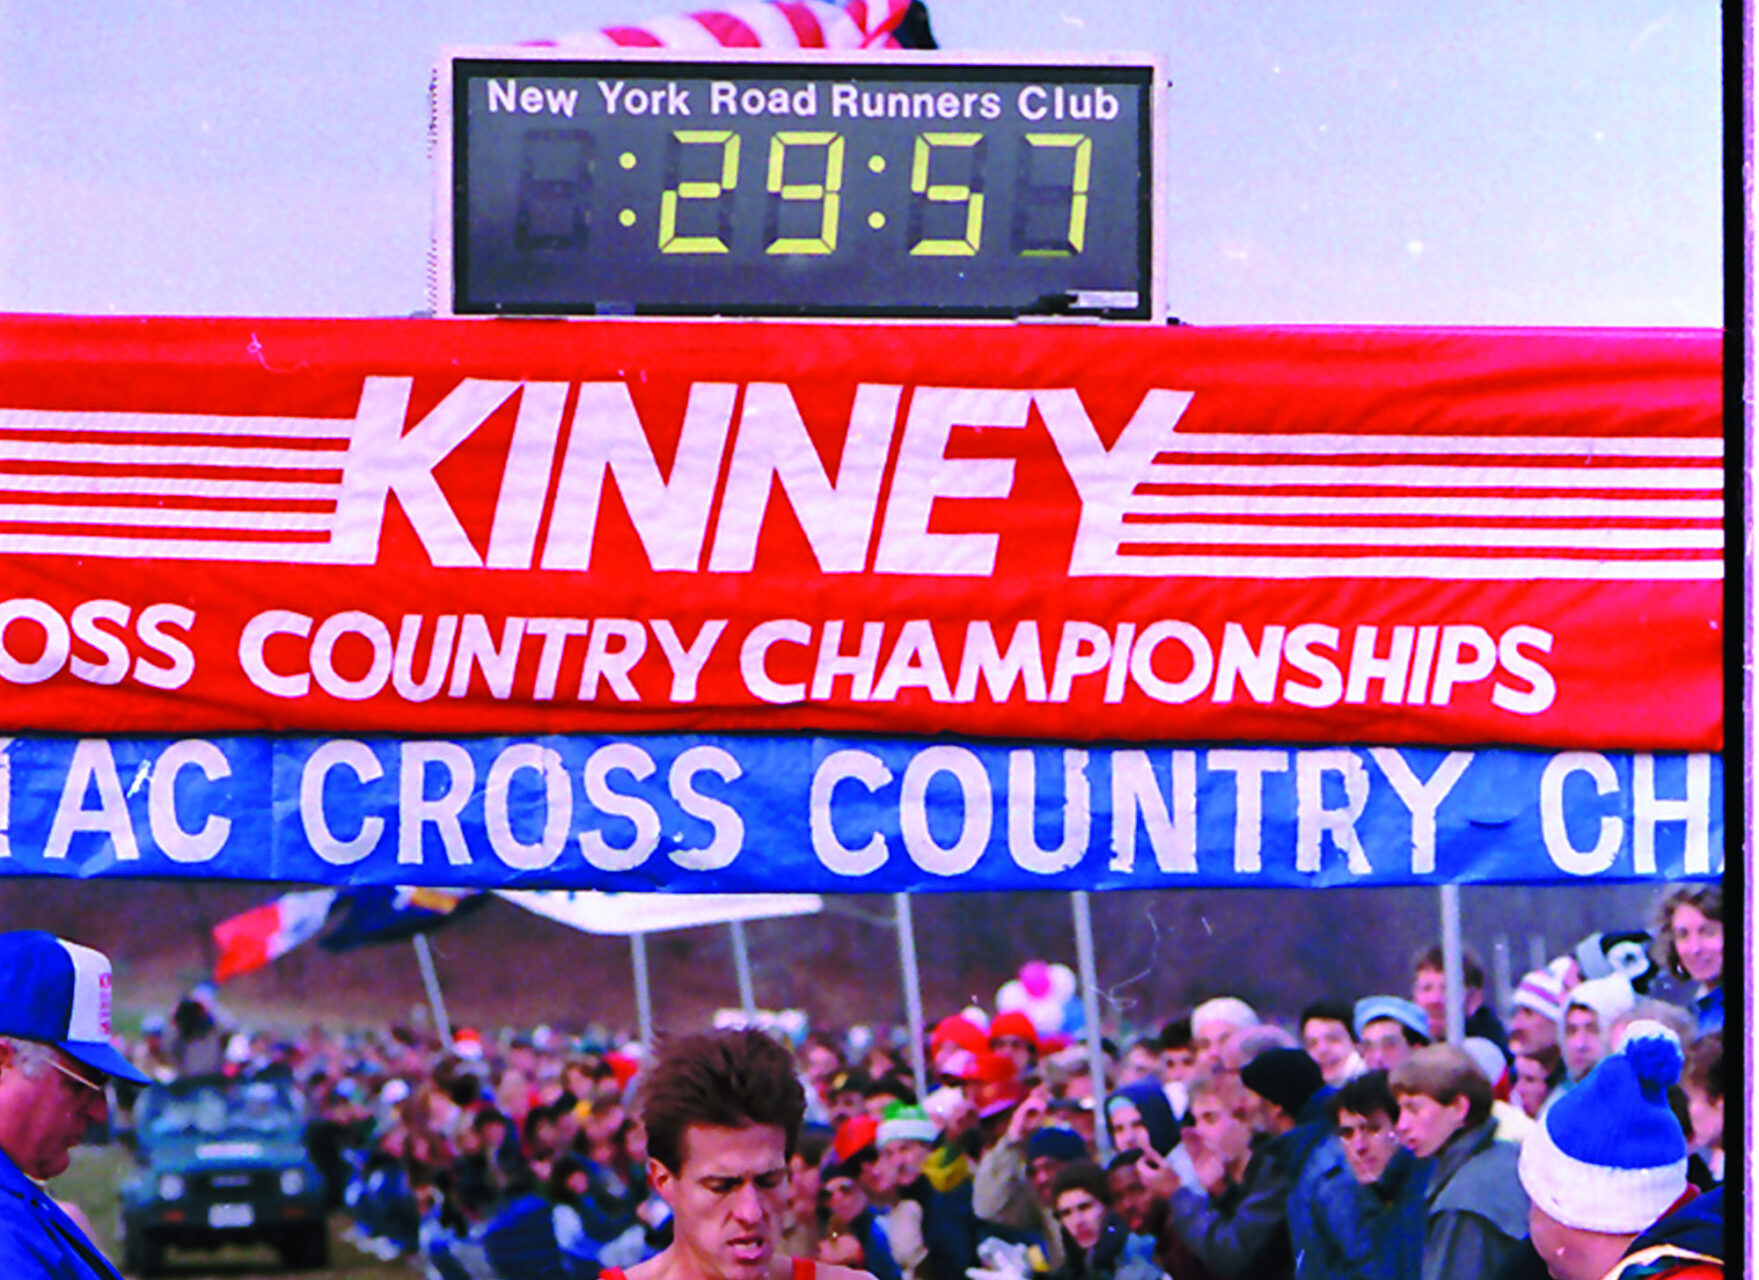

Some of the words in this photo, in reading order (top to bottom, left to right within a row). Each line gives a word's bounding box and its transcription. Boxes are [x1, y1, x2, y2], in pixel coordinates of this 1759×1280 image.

[487, 79, 579, 118] New
[598, 80, 691, 115] York
[711, 81, 816, 117] Road
[832, 83, 1001, 119] Runners
[1018, 86, 1119, 119] Club
[329, 376, 1196, 577] KINNEY
[238, 609, 729, 703] COUNTRY
[739, 618, 1557, 716] CHAMPIONSHIPS
[0, 737, 232, 863] AC
[300, 740, 744, 871] CROSS
[810, 745, 1474, 876] COUNTRY
[1540, 751, 1724, 876] CH
